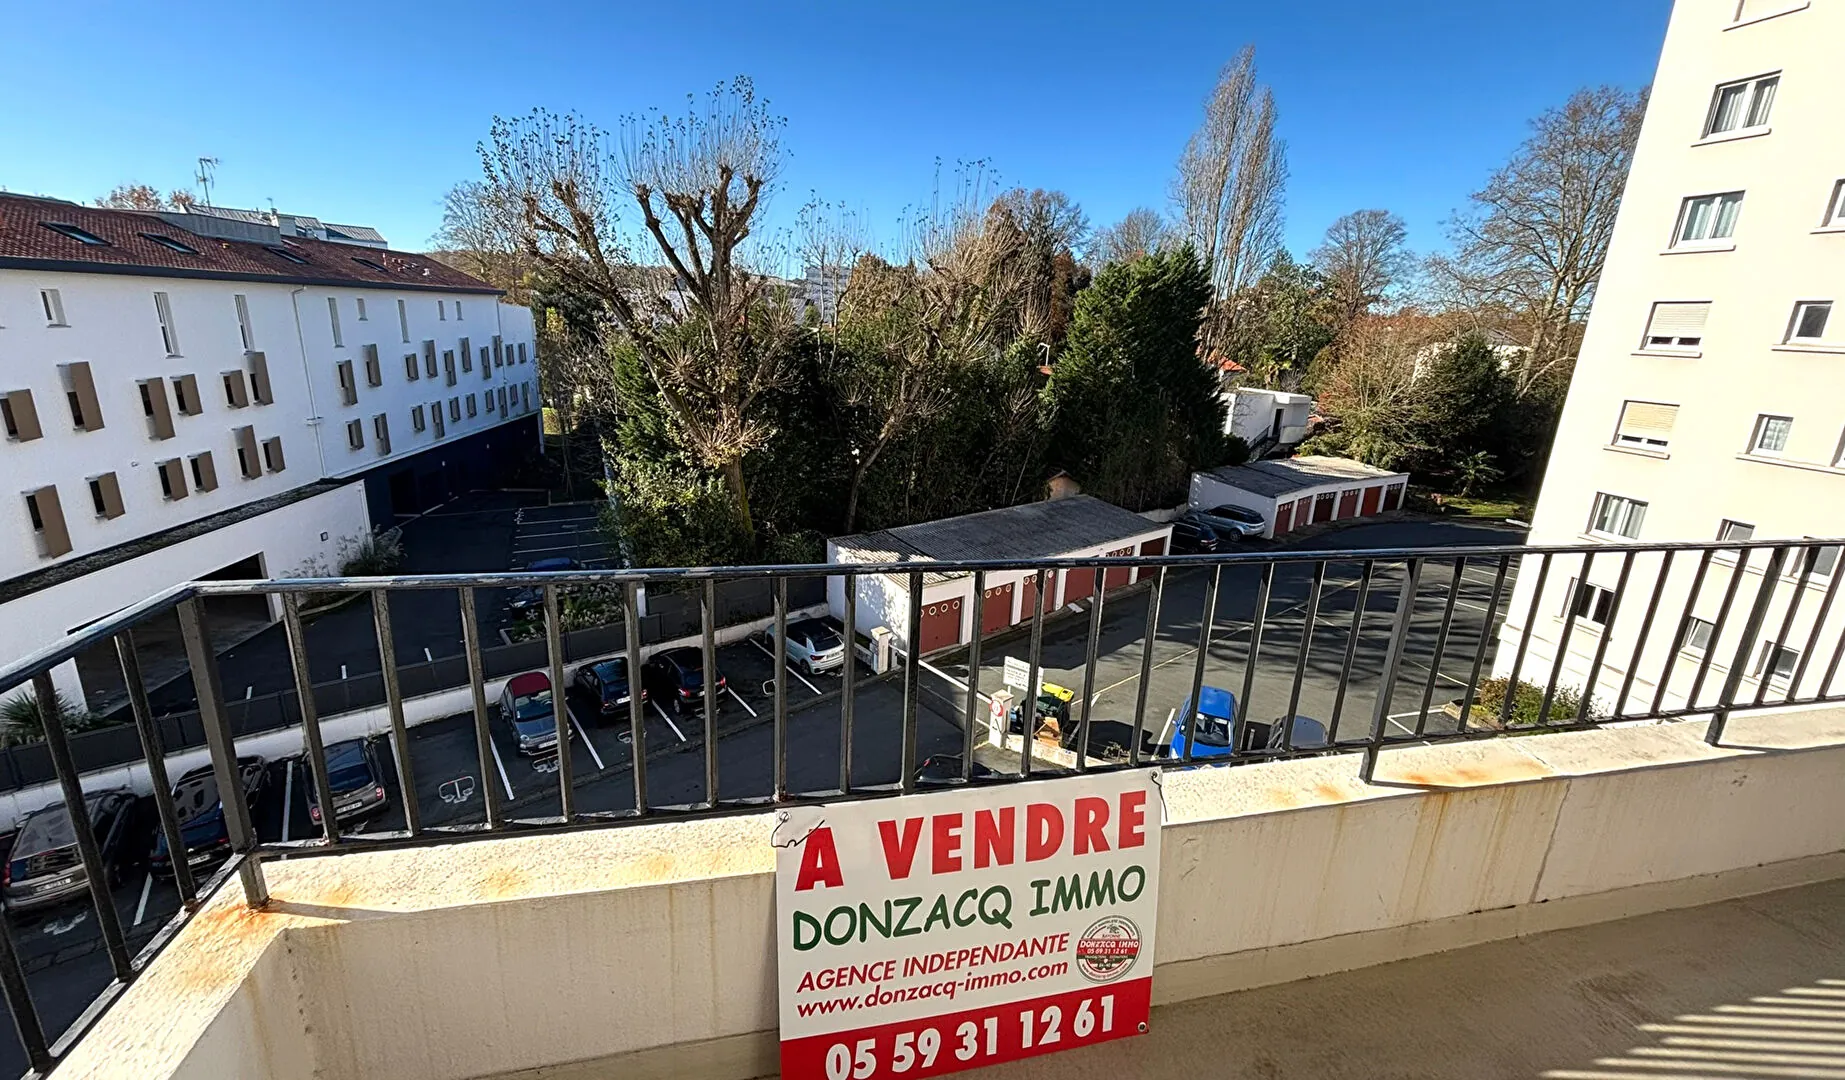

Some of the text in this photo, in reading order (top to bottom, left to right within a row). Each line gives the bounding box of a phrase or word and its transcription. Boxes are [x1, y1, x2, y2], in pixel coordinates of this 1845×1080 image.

[794, 790, 1146, 892] A VENDRE
[793, 865, 1146, 951] DONZACQ IMMO
[796, 960, 897, 994] AGENCE
[902, 932, 1070, 978] INDEPENDANTE
[797, 961, 1069, 1018] www.donzacq-immo.com
[825, 994, 1115, 1080] 05 59 31 12 61
